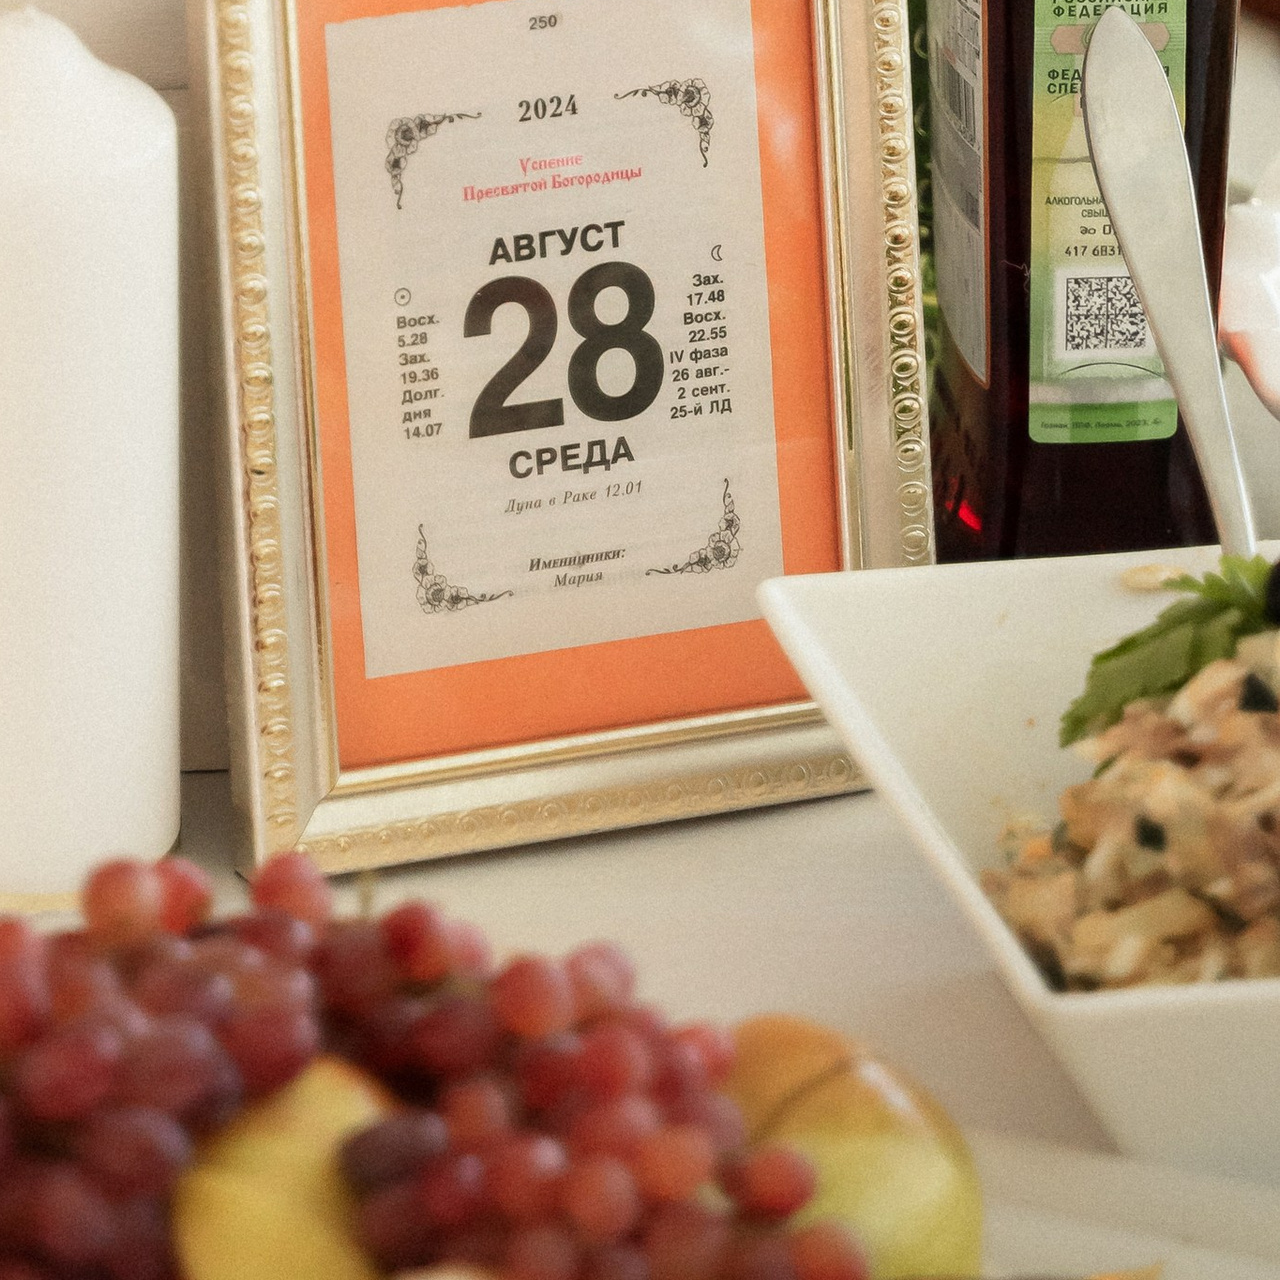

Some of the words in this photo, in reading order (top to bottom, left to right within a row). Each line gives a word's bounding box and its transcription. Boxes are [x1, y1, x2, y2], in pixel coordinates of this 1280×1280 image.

[1052, 2, 1168, 18] ФЕДЕЦИЯ
[528, 14, 558, 30] 250
[518, 94, 579, 122] 2024
[519, 154, 583, 176] Успение
[463, 176, 548, 202] Пресвятой
[551, 167, 642, 190] Богородицы
[1045, 196, 1106, 206] АЛКОГОЛЬНА
[488, 220, 626, 265] АВГУСТ
[1064, 245, 1088, 257] 417
[692, 273, 724, 288] Зах.
[686, 289, 725, 306] 17.48
[396, 314, 440, 329] Восх.
[684, 308, 726, 325] Восх.
[397, 331, 428, 347] 5.28
[688, 326, 728, 343] 22.55
[398, 350, 431, 366] Зах.
[463, 261, 665, 439] 28
[669, 350, 685, 364] IV
[689, 346, 729, 364] фаза
[400, 368, 440, 385] 19.36
[672, 367, 690, 382] 26
[401, 386, 445, 406] Долг.
[677, 386, 686, 400] 2
[691, 384, 731, 398] сент.
[402, 407, 432, 424] дня
[670, 401, 704, 419] 25-й
[709, 398, 733, 416] ЛД
[403, 423, 443, 440] 14.07
[508, 436, 636, 479] СРЕДА
[504, 496, 542, 516] Луна
[548, 495, 556, 507] в
[563, 489, 598, 505] Раке
[605, 480, 643, 499] 12.01
[553, 570, 604, 589] Мария
